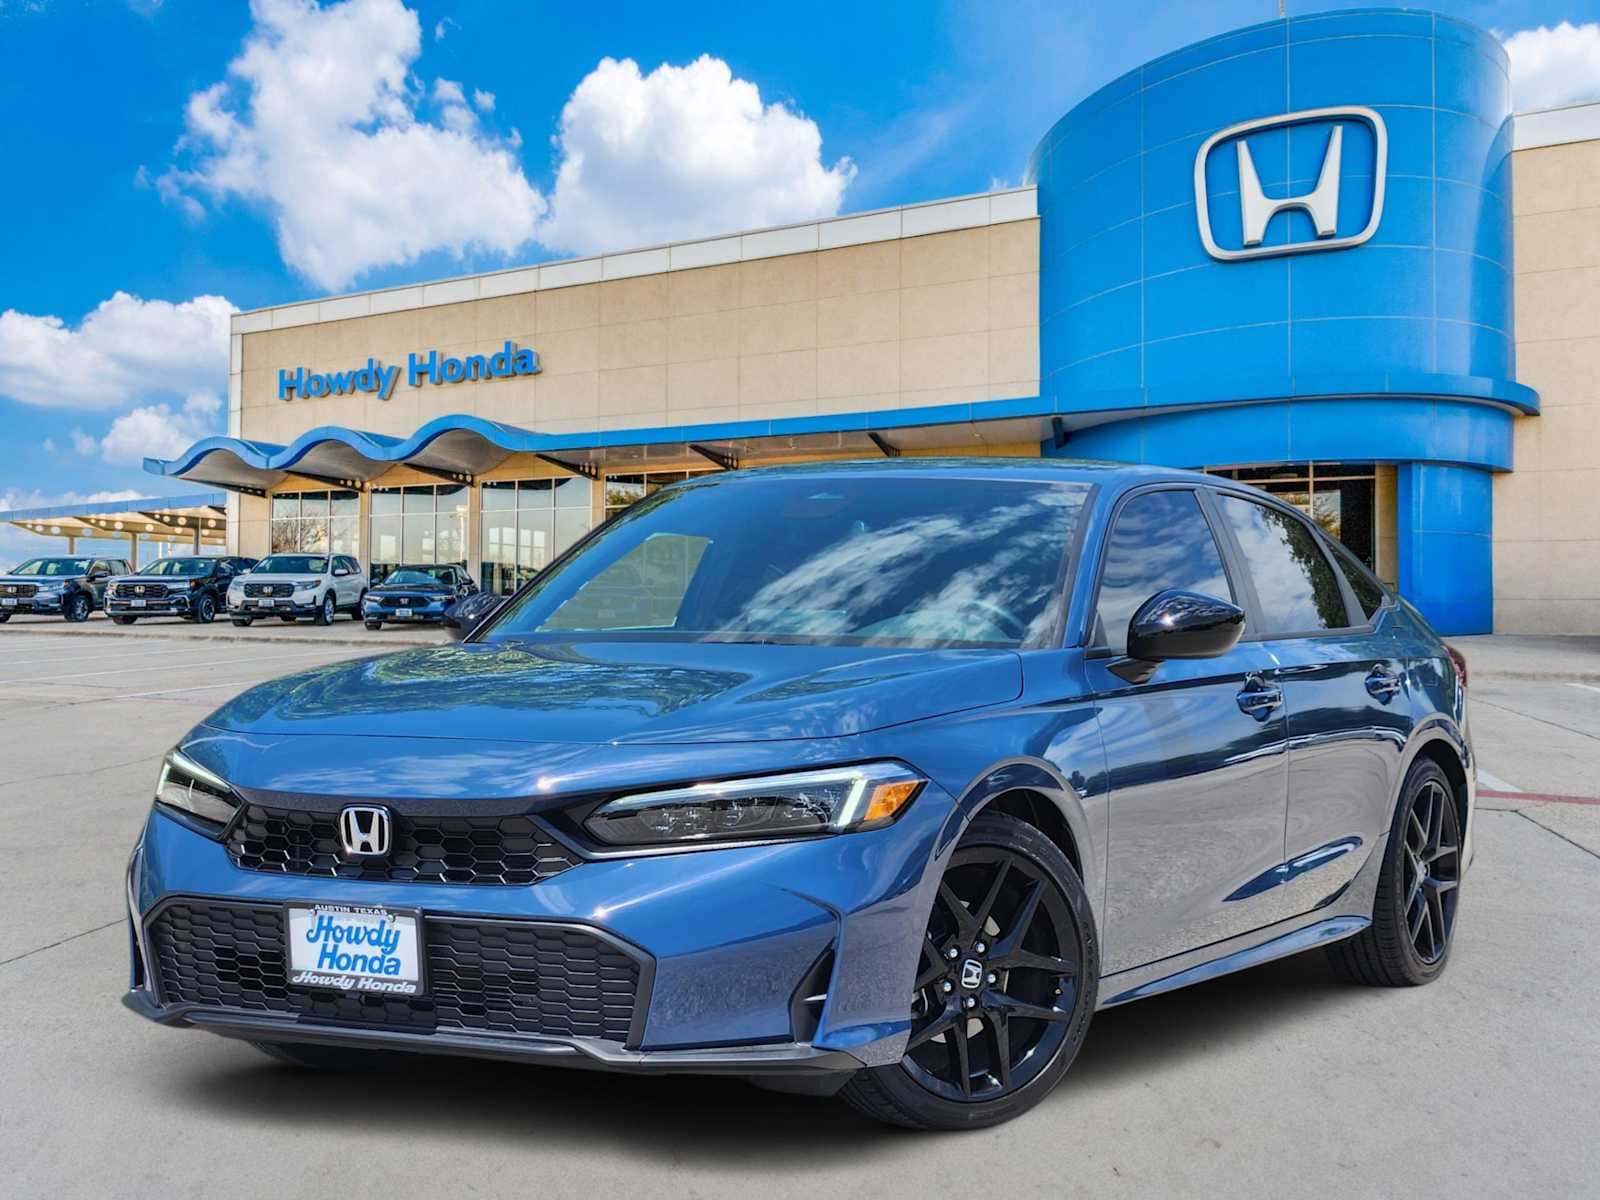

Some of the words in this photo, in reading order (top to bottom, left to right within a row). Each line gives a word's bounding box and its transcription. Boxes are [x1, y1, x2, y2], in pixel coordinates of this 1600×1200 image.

[278, 357, 400, 400] Howdy
[407, 340, 541, 387] Honda
[314, 904, 350, 913] AUSTIN
[355, 907, 388, 916] TEXAS
[306, 914, 402, 955] Howdy
[317, 942, 402, 976] Honda
[292, 971, 355, 990] Howdy
[357, 977, 417, 994] Honda
